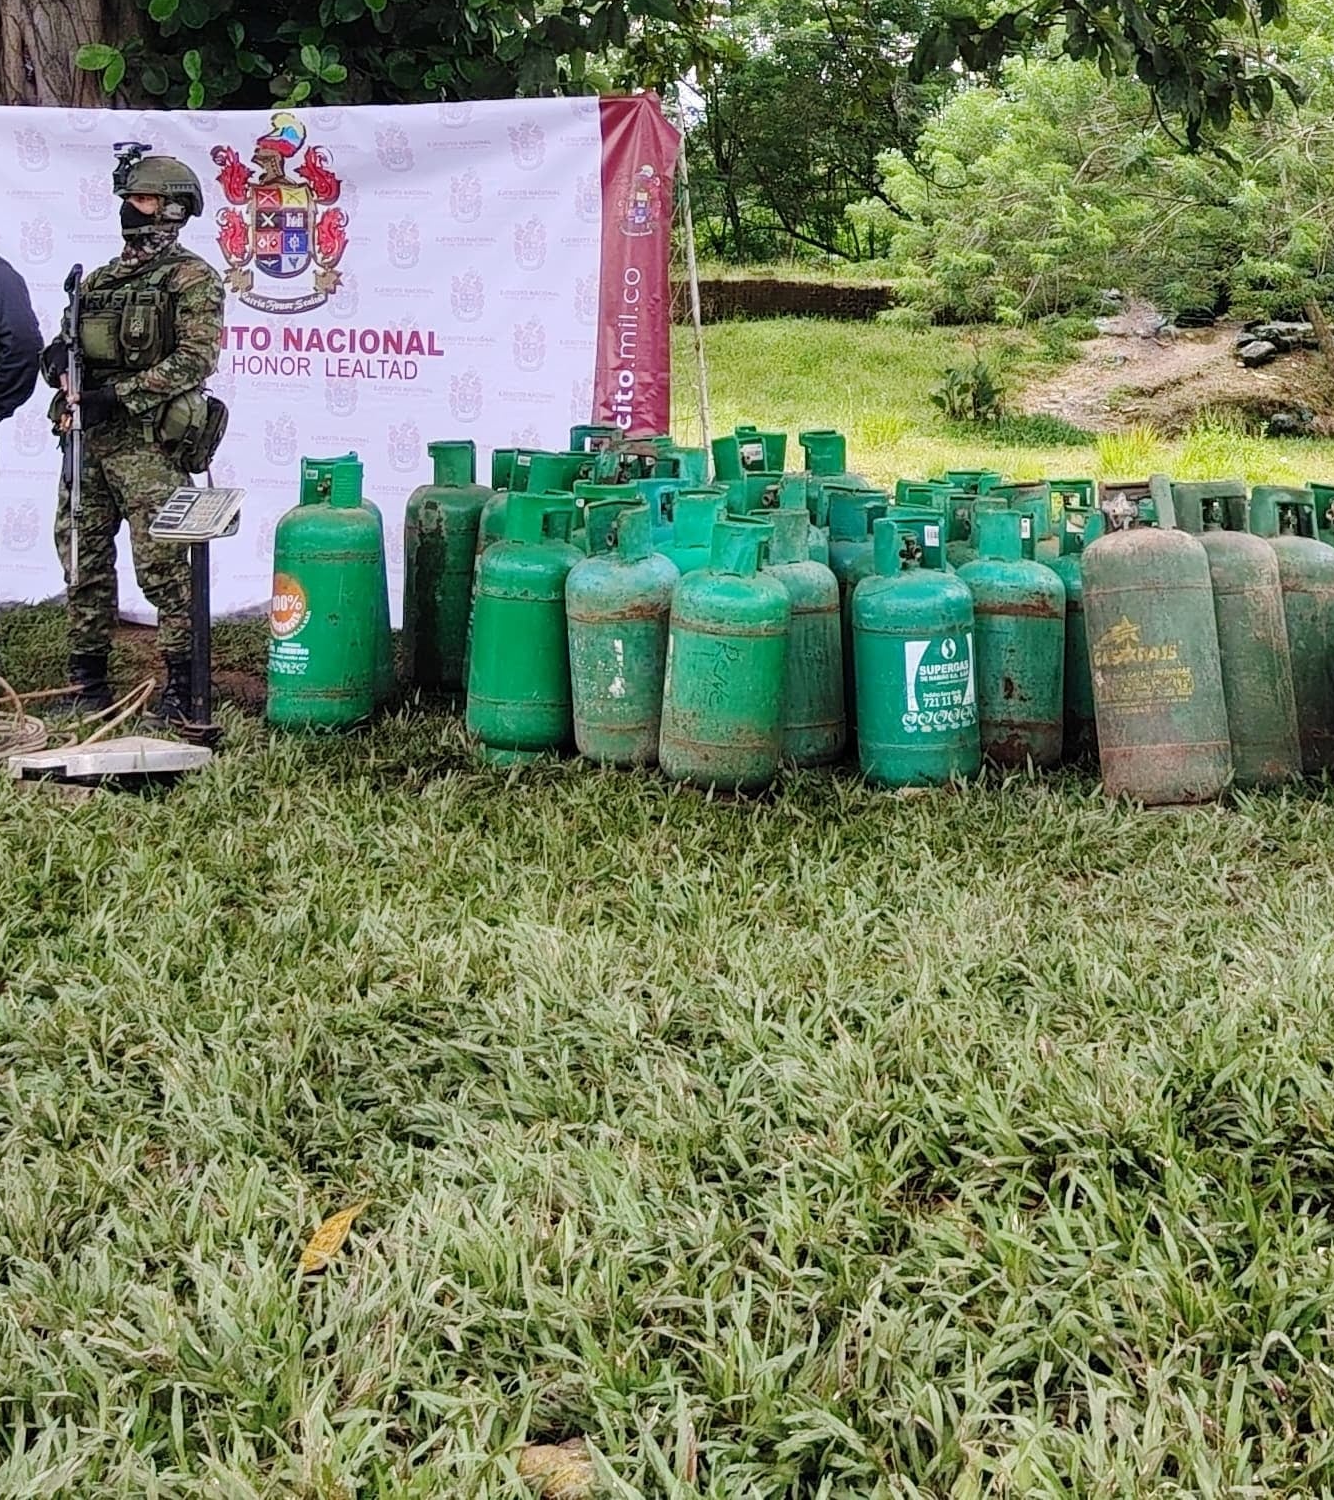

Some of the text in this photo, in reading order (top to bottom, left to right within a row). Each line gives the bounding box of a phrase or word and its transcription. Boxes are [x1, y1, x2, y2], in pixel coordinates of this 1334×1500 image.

[222, 326, 444, 356] ITO NACIONAL
[612, 267, 640, 431] cito.mil.co
[232, 355, 418, 380] HONOR LEALTAD
[272, 594, 302, 612] 100%
[919, 660, 969, 675] SUPERGAS
[923, 698, 940, 707] 721
